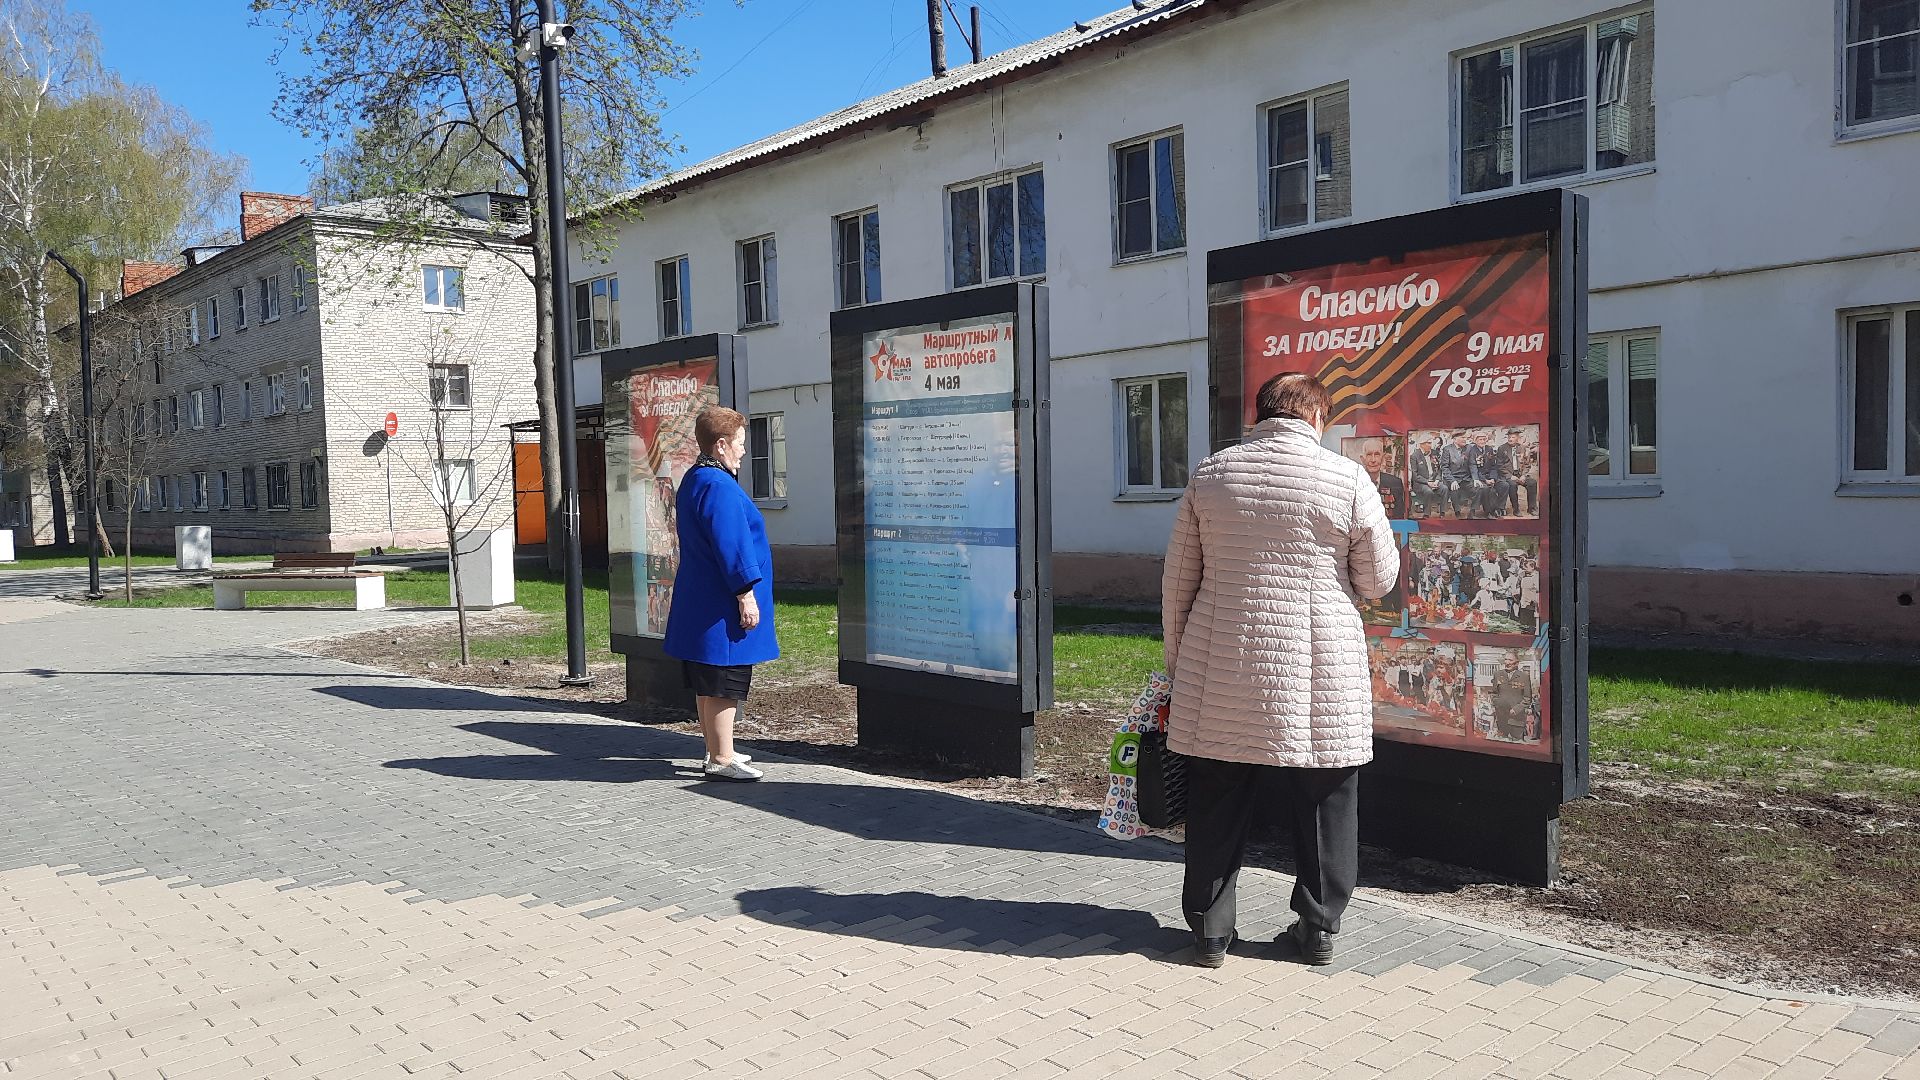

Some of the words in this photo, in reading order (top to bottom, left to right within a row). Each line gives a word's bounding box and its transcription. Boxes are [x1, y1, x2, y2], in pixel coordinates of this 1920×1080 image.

[1299, 272, 1440, 322] Спасибо
[923, 326, 999, 351] Маршрутный
[1262, 334, 1291, 358] ЗА
[1296, 321, 1402, 354] ПОБЕДУ!
[1466, 331, 1492, 363] 9
[1493, 332, 1545, 356] МАЯ
[893, 357, 912, 369] МАЯ
[924, 347, 996, 371] автопробега
[650, 373, 698, 397] Спасибо
[925, 374, 932, 392] 4
[936, 375, 961, 391] мая
[1427, 367, 1473, 400] 78
[1469, 372, 1530, 396] лет
[1122, 746, 1135, 761] F
